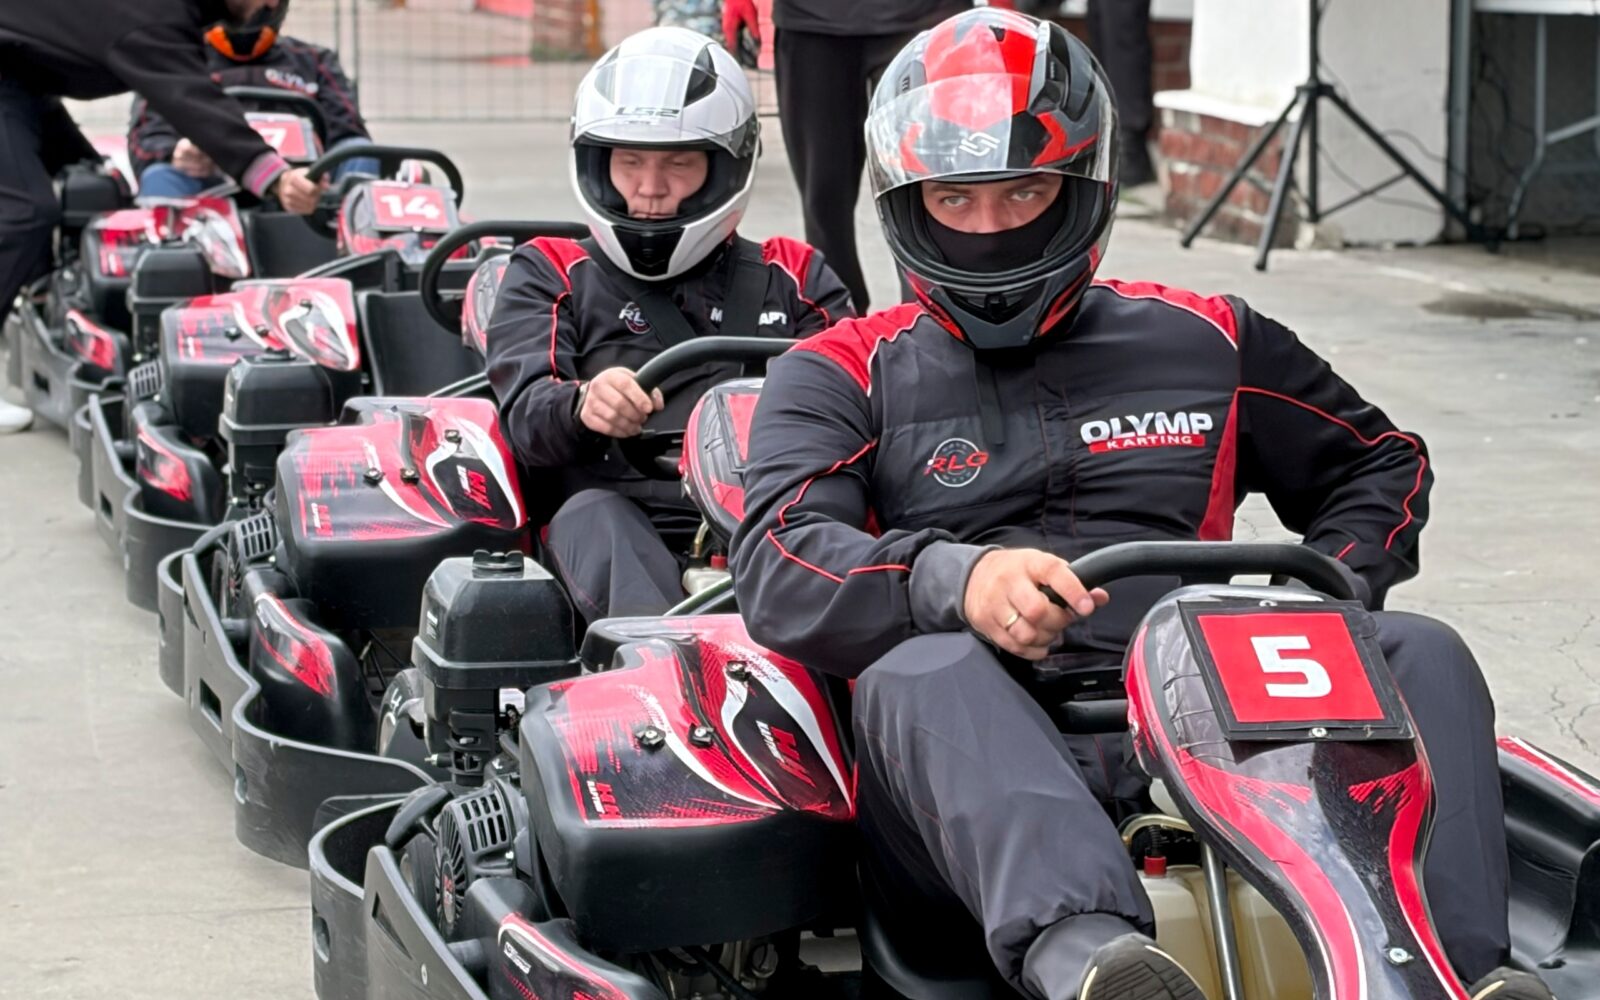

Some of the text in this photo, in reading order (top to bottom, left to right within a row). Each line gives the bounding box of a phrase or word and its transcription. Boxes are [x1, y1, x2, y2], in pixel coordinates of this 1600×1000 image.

[380, 195, 440, 219] 14
[1080, 411, 1213, 444] OLYMP
[1107, 435, 1193, 450] KARTING
[1250, 635, 1332, 698] 5
